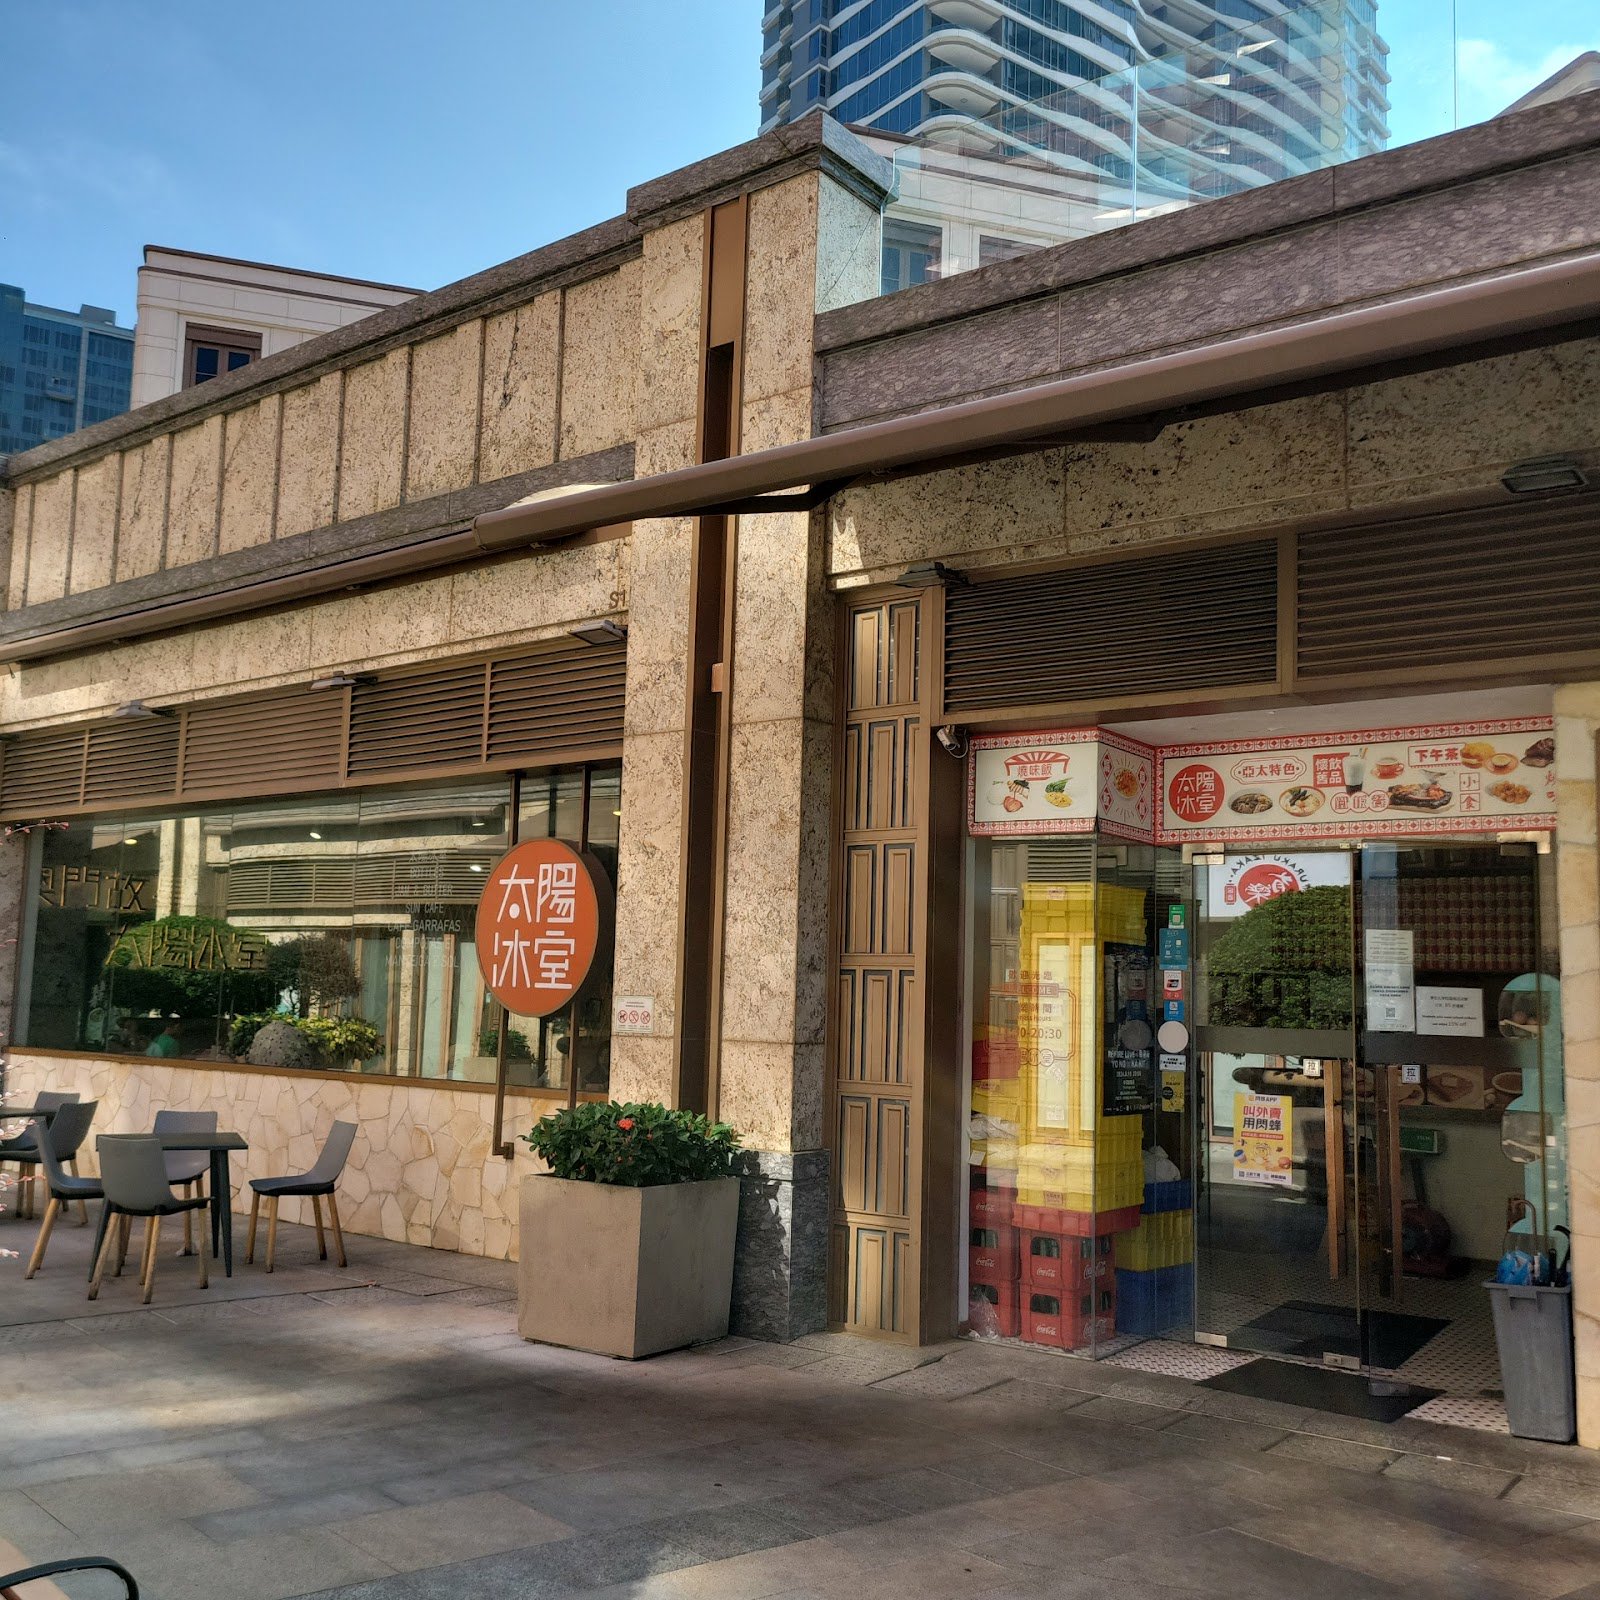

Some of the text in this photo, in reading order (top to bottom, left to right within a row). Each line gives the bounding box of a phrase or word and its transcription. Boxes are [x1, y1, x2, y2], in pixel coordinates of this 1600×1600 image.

[1414, 747, 1459, 763] 下午茶
[1017, 763, 1053, 778] 燒味飯
[1242, 762, 1296, 778] 亞太特色
[1178, 771, 1215, 793] 太陽
[1461, 775, 1479, 810] 小食
[1176, 794, 1216, 815] 冰室
[497, 863, 577, 923] 太陽
[405, 902, 420, 914] SUN
[413, 919, 461, 932] GARRAFAS
[104, 923, 269, 970] 太陽冰室
[492, 929, 576, 989] 冰室
[1407, 1067, 1416, 1077] 拉
[1243, 1105, 1282, 1119] 叫外賣
[1243, 1117, 1282, 1131] 用閃蜂
